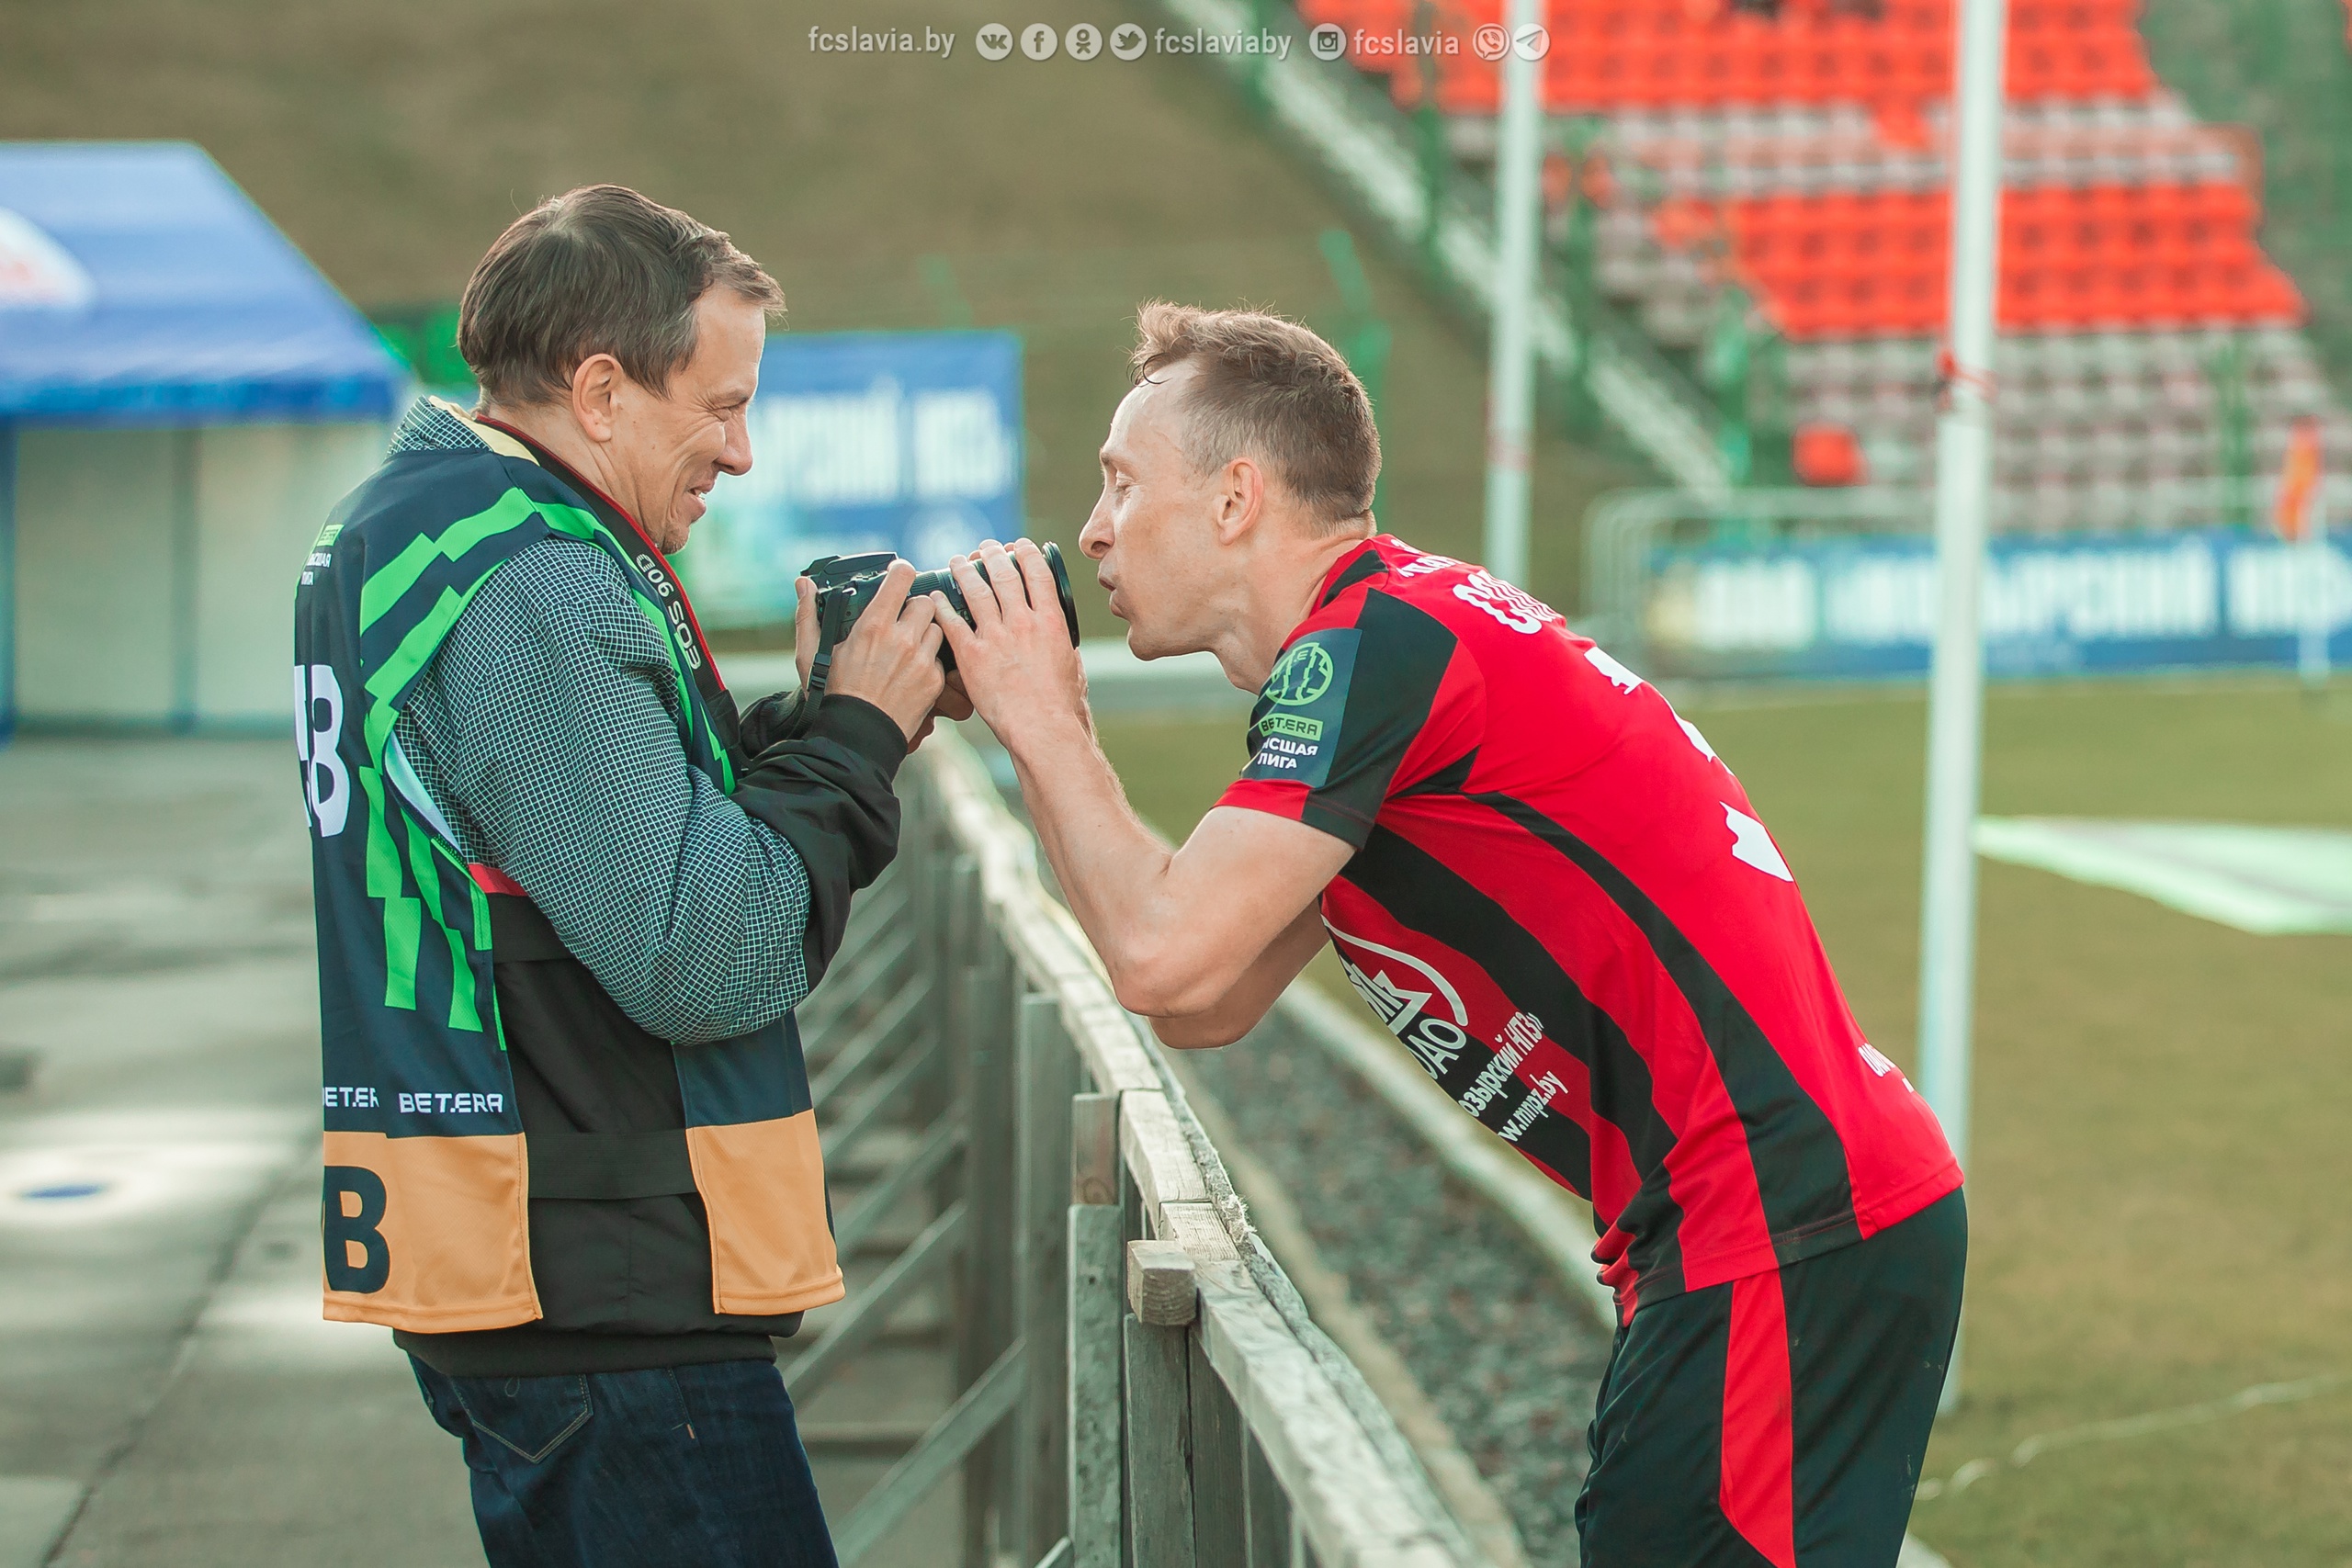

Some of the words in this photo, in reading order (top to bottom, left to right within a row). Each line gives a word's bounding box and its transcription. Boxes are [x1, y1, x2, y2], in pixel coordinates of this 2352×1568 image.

[636, 553, 674, 597] 90D
[668, 600, 702, 670] EOS
[1257, 752, 1297, 769] ЛИГА
[1262, 737, 1319, 756] СШАЯ
[1457, 1033, 1524, 1118] озырский
[398, 1092, 504, 1114] BET.ERA
[1497, 1070, 1569, 1142] w.mnpz.by
